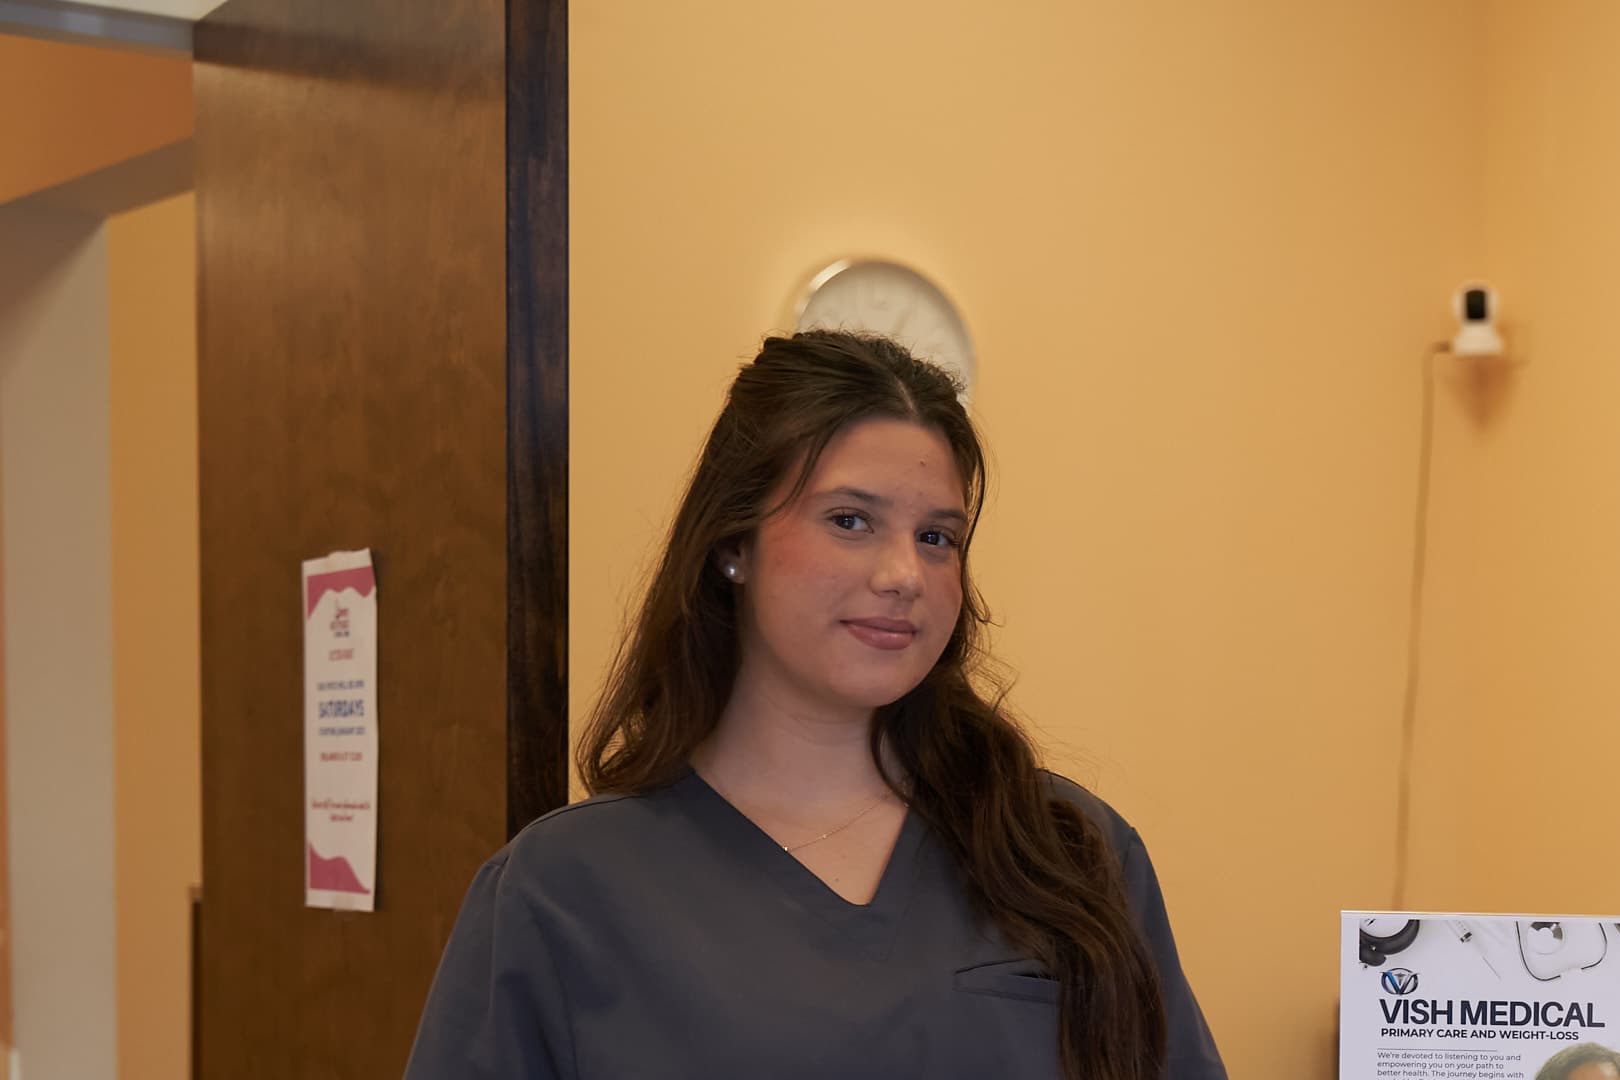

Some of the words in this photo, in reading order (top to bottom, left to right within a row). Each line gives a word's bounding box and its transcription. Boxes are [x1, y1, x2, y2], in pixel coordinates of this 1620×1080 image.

[1379, 998, 1453, 1025] VISH
[1459, 1000, 1605, 1028] MEDICAL
[1381, 1028, 1434, 1038] PRIMARY
[1436, 1029, 1467, 1038] CARE
[1470, 1030, 1496, 1039] AND
[1498, 1030, 1579, 1040] WEIGHT-LOSS
[1377, 1051, 1400, 1059] We're
[1401, 1052, 1433, 1060] devoted
[1434, 1052, 1443, 1060] to
[1444, 1052, 1478, 1062] listening
[1480, 1053, 1488, 1061] to
[1489, 1054, 1504, 1062] you
[1505, 1053, 1521, 1061] and
[1376, 1061, 1427, 1070] empowering
[1428, 1062, 1443, 1070] you
[1456, 1063, 1474, 1071] your
[1475, 1062, 1494, 1071] path
[1377, 1069, 1401, 1077] better
[1402, 1069, 1429, 1077] health.
[1431, 1070, 1446, 1078] The
[1446, 1070, 1477, 1079] journey
[1478, 1070, 1505, 1080] begins
[1506, 1071, 1524, 1079] with
